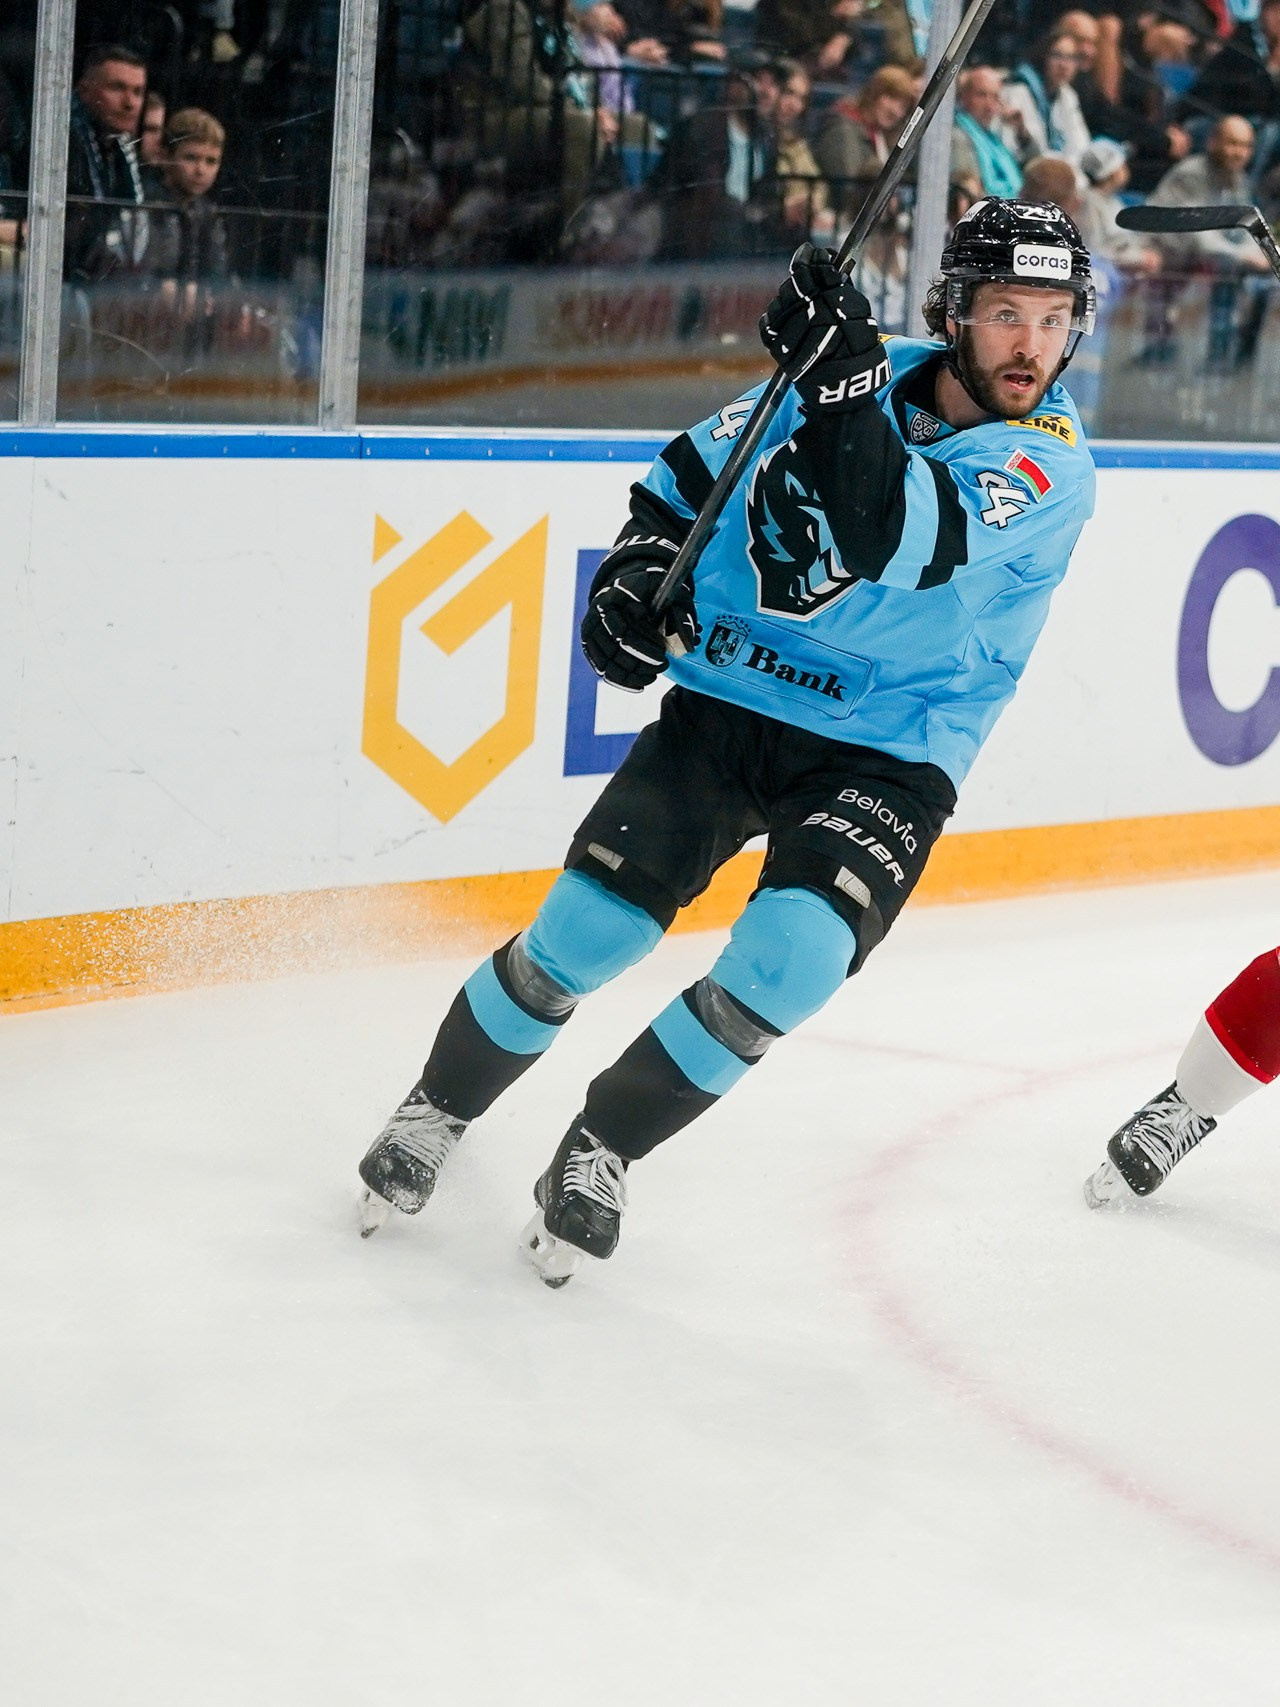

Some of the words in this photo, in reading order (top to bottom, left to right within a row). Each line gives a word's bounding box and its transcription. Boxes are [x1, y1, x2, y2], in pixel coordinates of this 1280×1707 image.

[1017, 254, 1069, 270] согаз
[742, 642, 848, 702] Bank
[799, 812, 903, 888] BAUER
[837, 788, 917, 855] Belavia
